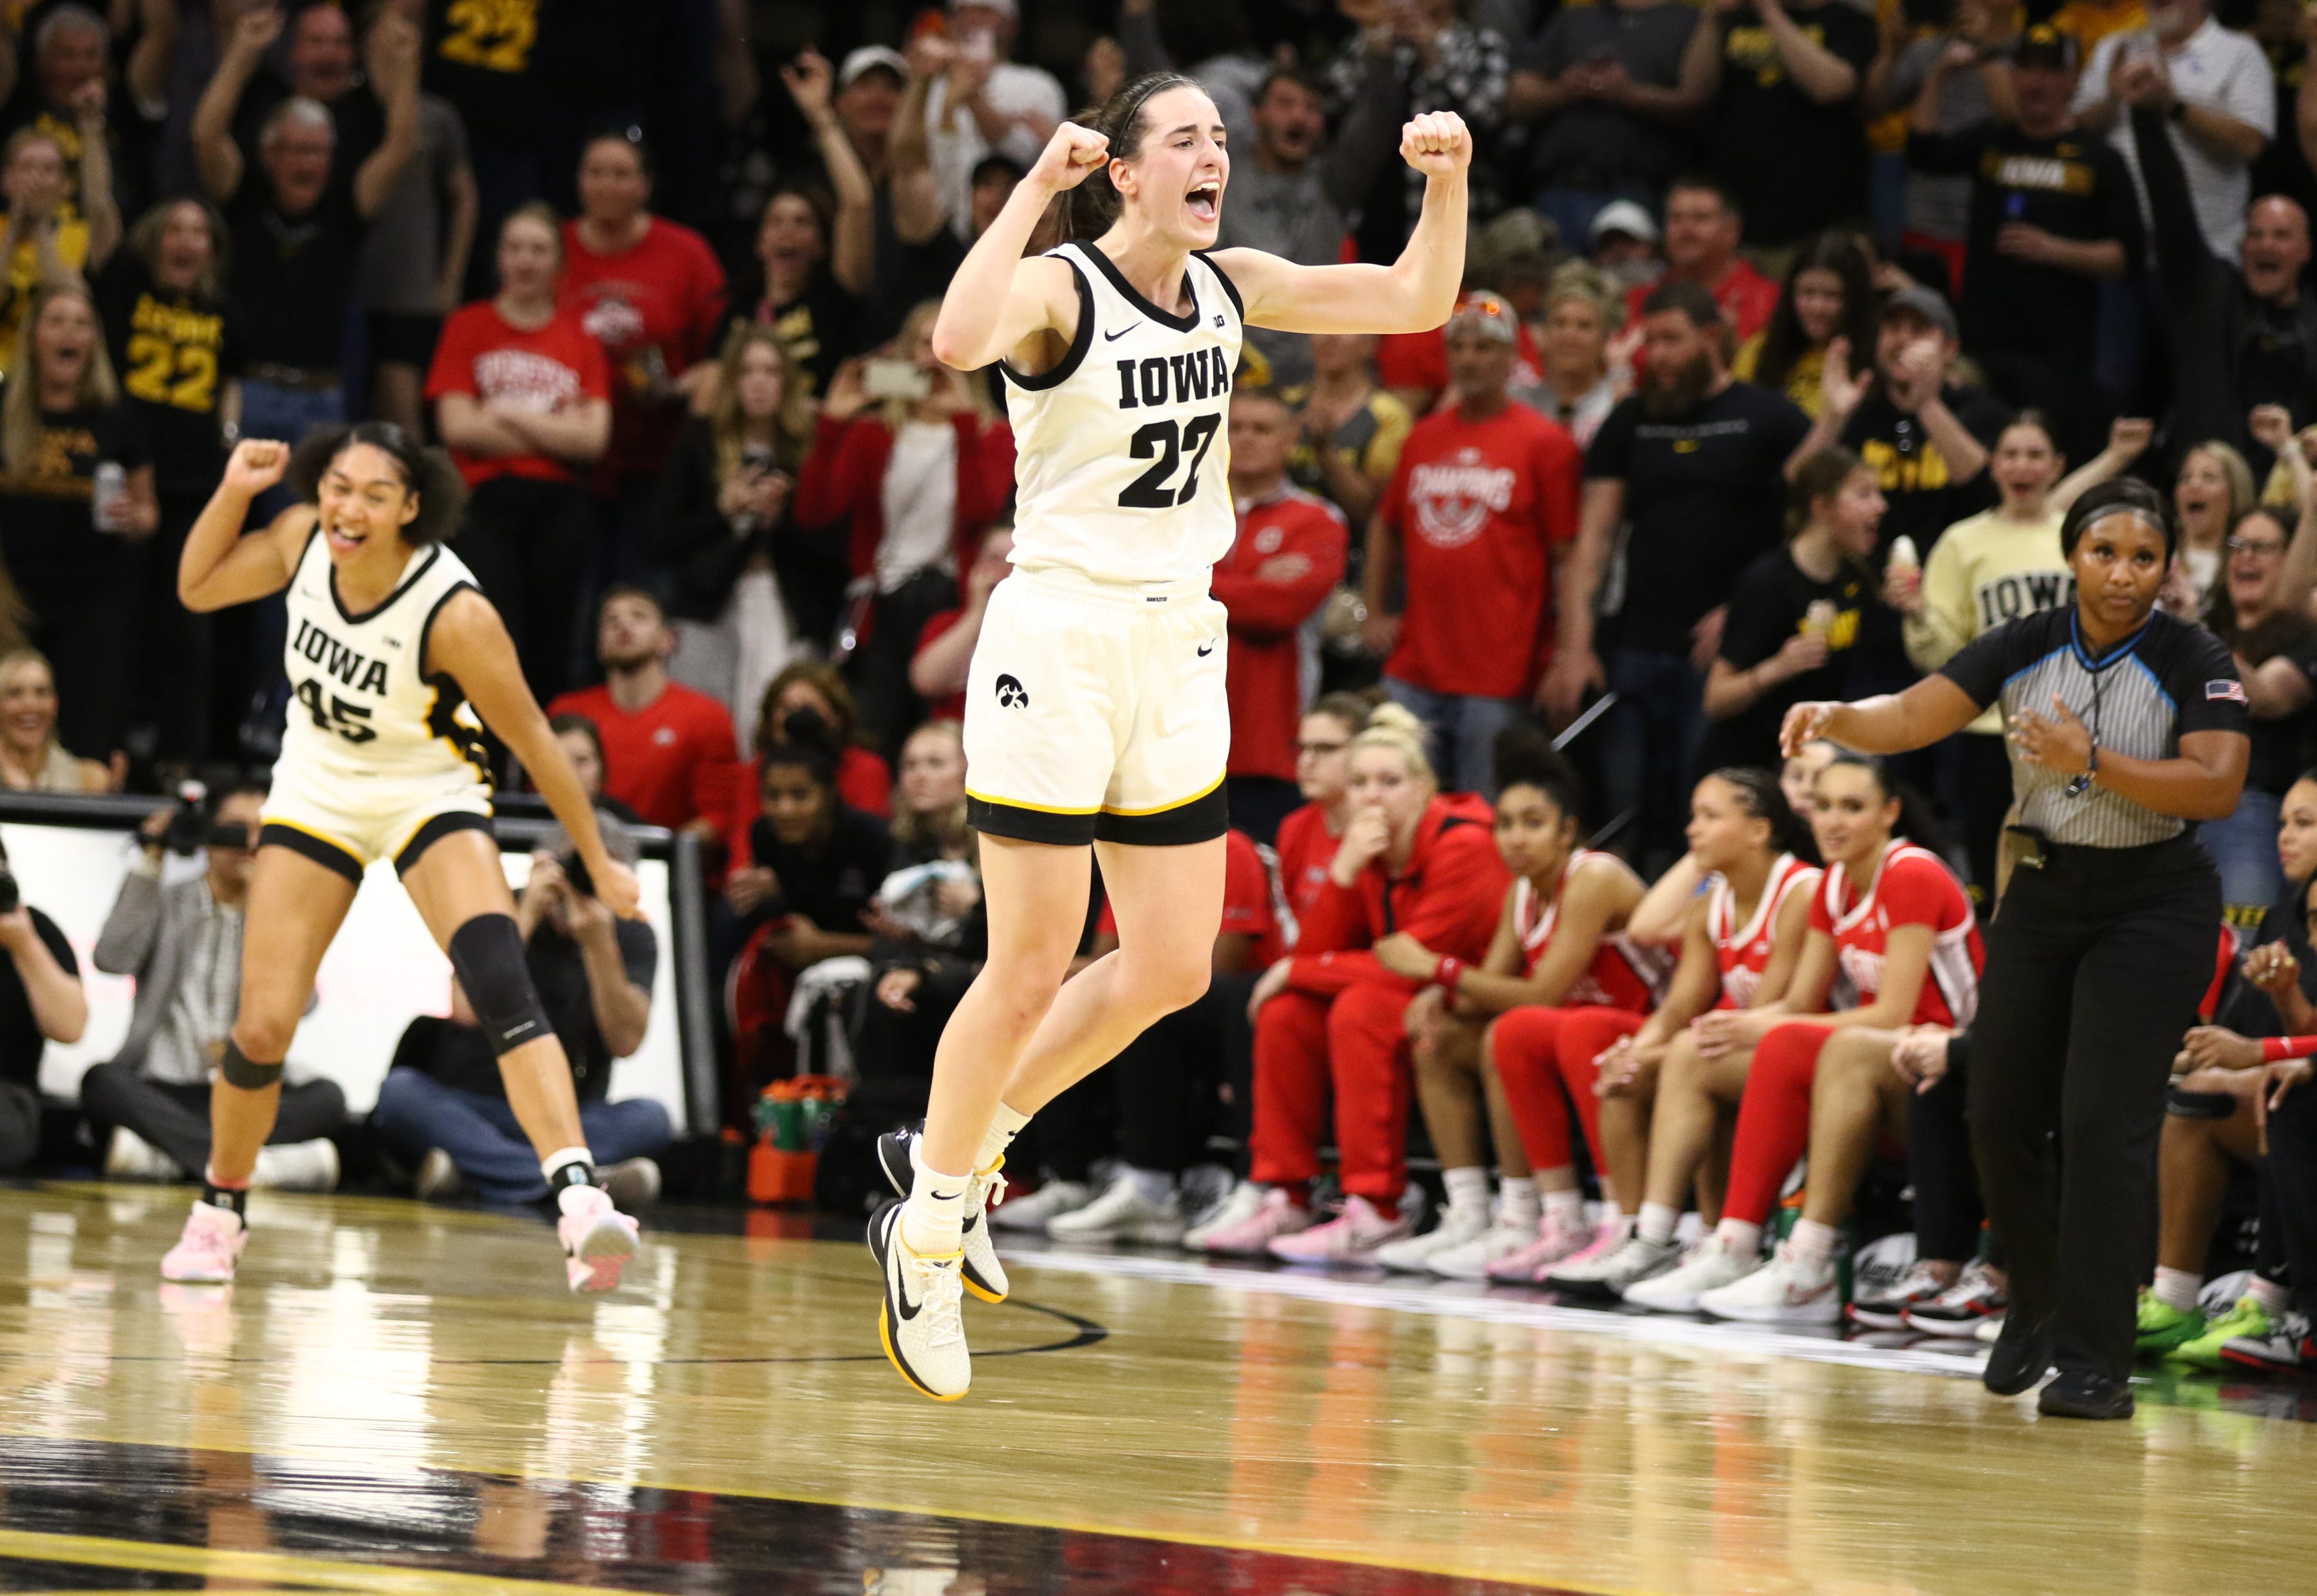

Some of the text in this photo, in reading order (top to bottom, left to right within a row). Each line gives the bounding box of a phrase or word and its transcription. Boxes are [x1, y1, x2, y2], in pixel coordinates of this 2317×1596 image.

[126, 335, 218, 413] 22
[1117, 346, 1229, 409] IOWA
[1118, 413, 1222, 508] 22
[293, 618, 388, 696] IOWA
[297, 678, 379, 745] 45
